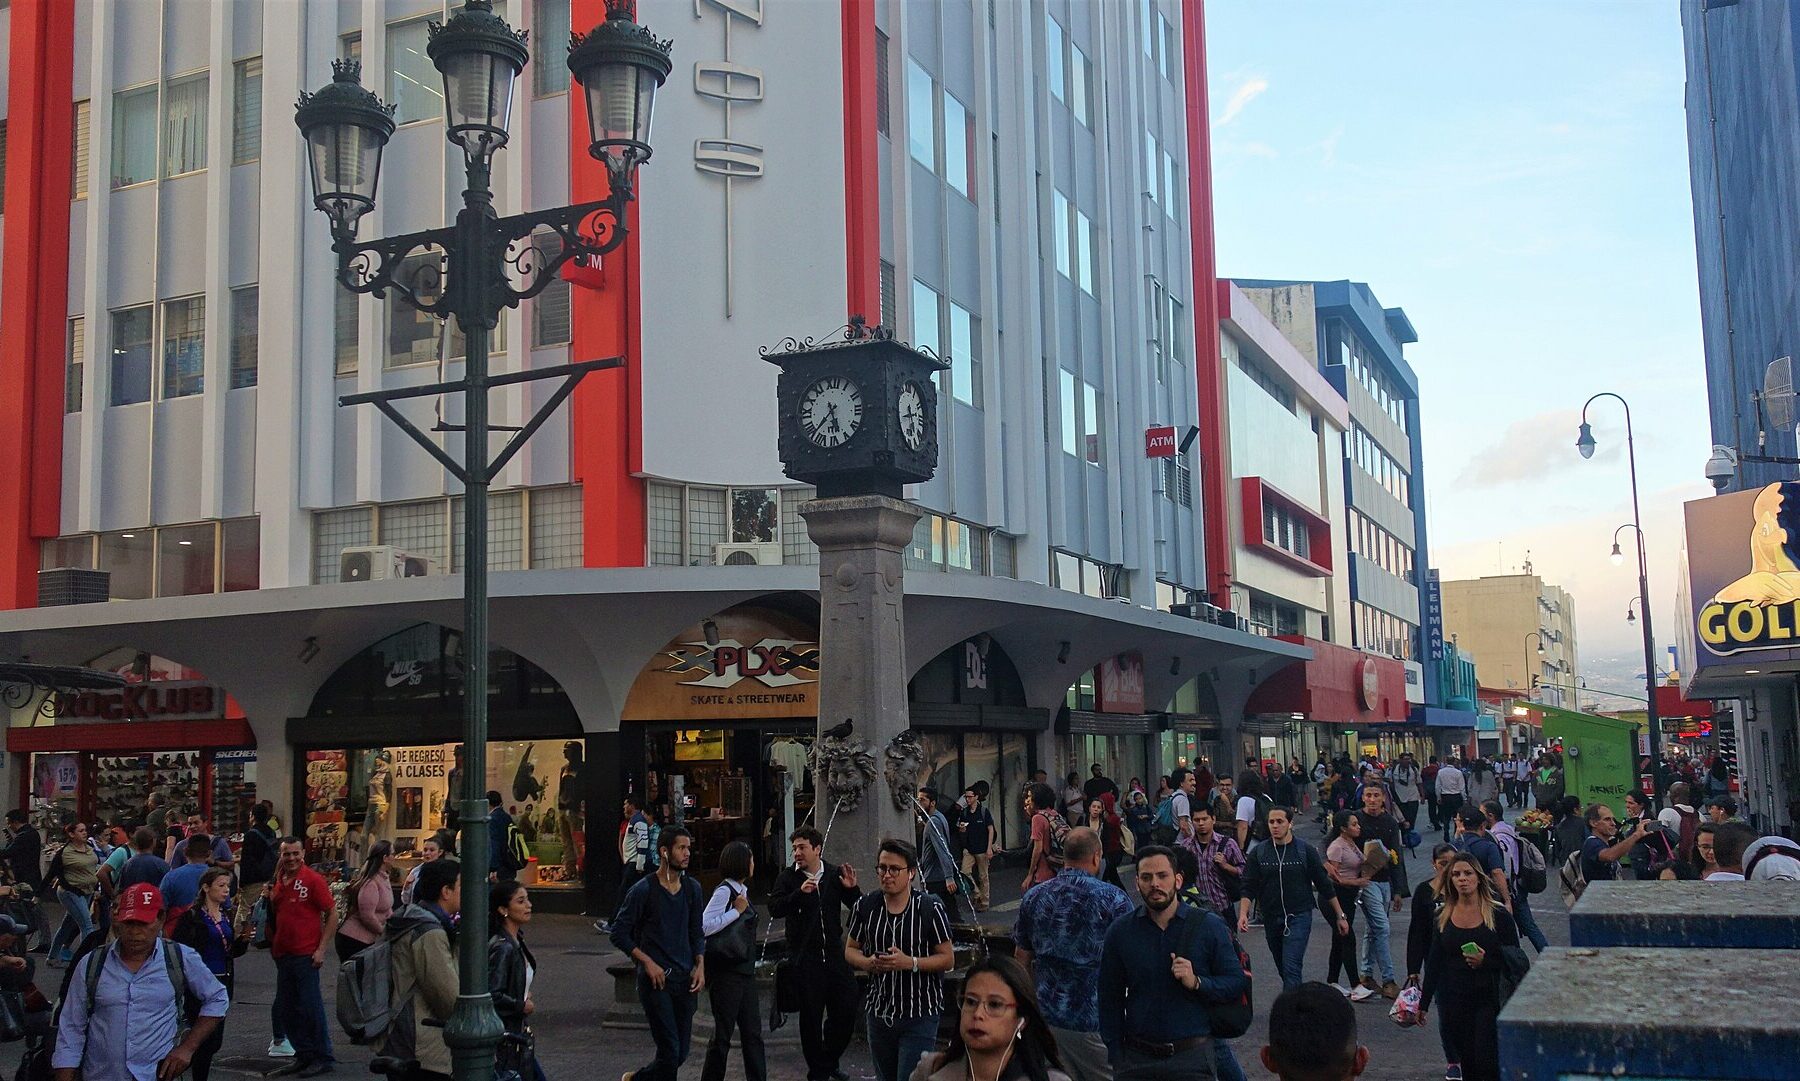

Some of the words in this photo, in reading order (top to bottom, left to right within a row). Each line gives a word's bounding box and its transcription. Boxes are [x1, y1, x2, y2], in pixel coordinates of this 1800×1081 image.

[1149, 435, 1174, 448] ATM
[1429, 583, 1441, 659] LEHMANN
[392, 660, 418, 674] NIKE
[408, 674, 422, 686] SB
[691, 695, 724, 705] SKATE
[736, 693, 806, 705] STREETWEAR
[396, 750, 407, 763] DE
[408, 749, 446, 763] REGRESO
[58, 767, 78, 783] 15%
[396, 765, 403, 778] A
[405, 764, 445, 778] CLASES
[142, 891, 154, 905] F
